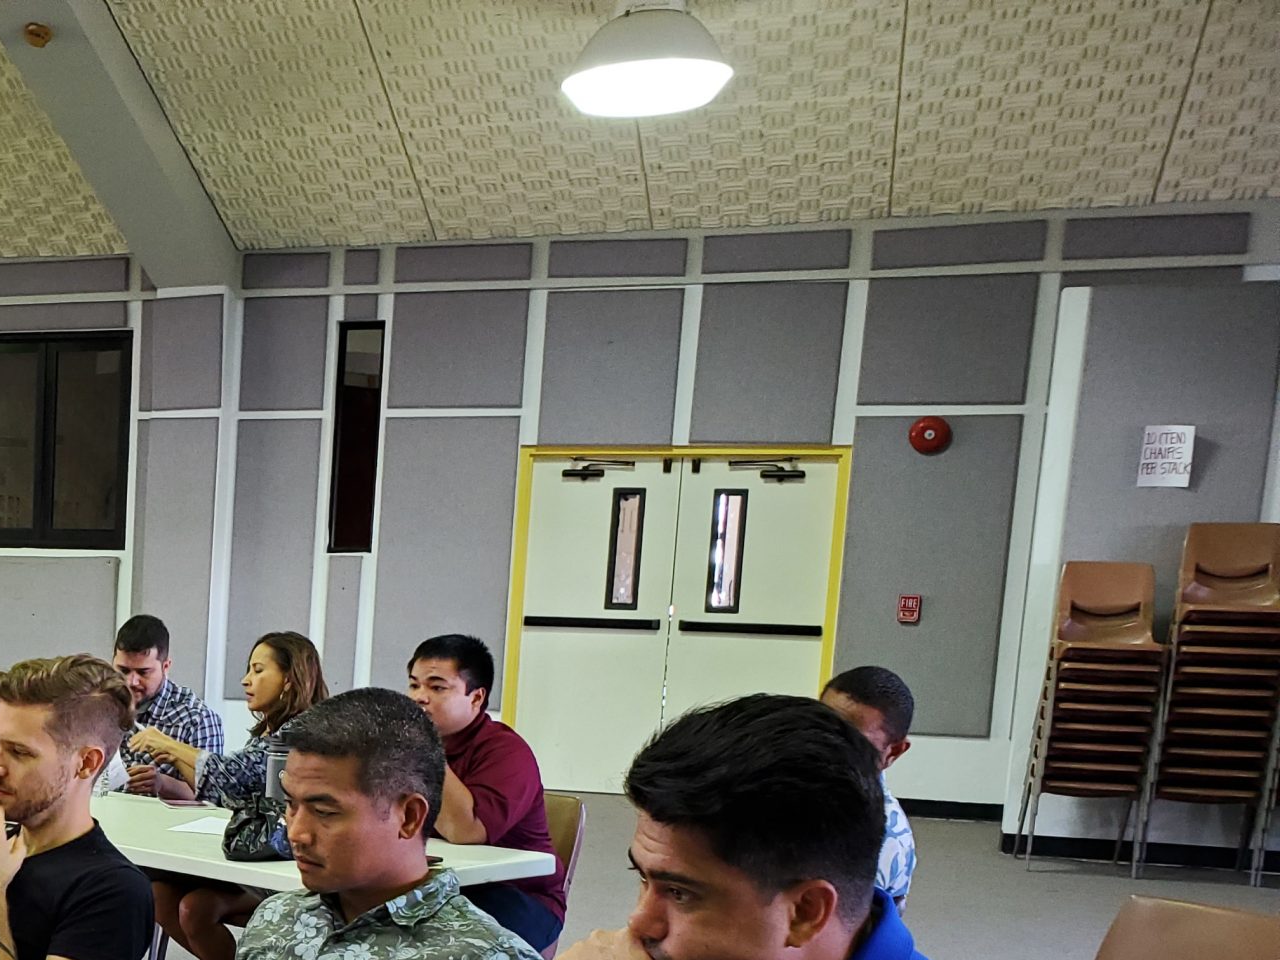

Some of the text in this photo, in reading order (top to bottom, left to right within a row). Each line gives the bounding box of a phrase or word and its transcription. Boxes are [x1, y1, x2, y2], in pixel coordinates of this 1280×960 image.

[1144, 447, 1183, 460] CHAIRS
[1141, 461, 1192, 475] PER STACK
[901, 598, 918, 609] FIRE
